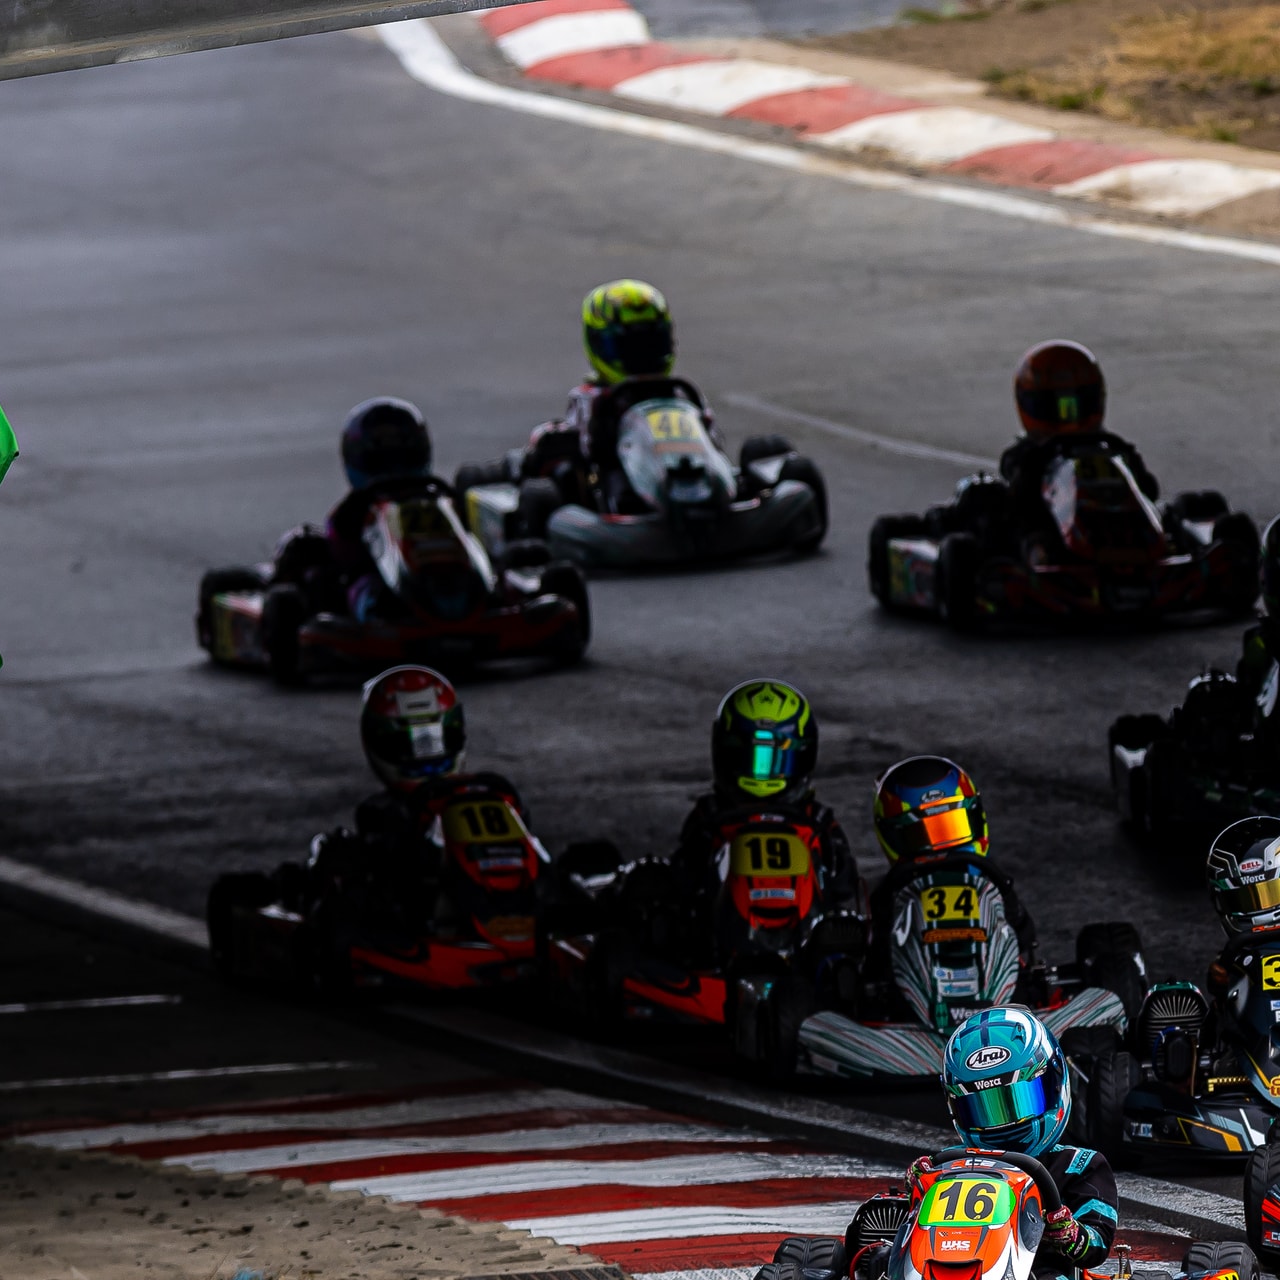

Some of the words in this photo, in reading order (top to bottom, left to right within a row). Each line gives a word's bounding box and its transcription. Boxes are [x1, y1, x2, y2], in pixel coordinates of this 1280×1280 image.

[462, 806, 510, 837] 18
[744, 838, 791, 870] 19
[1241, 861, 1261, 870] BELL
[1240, 874, 1266, 885] Wera
[927, 888, 973, 919] 34
[971, 1048, 1005, 1067] Arai
[974, 1078, 1002, 1090] Wera
[939, 1182, 997, 1220] 16
